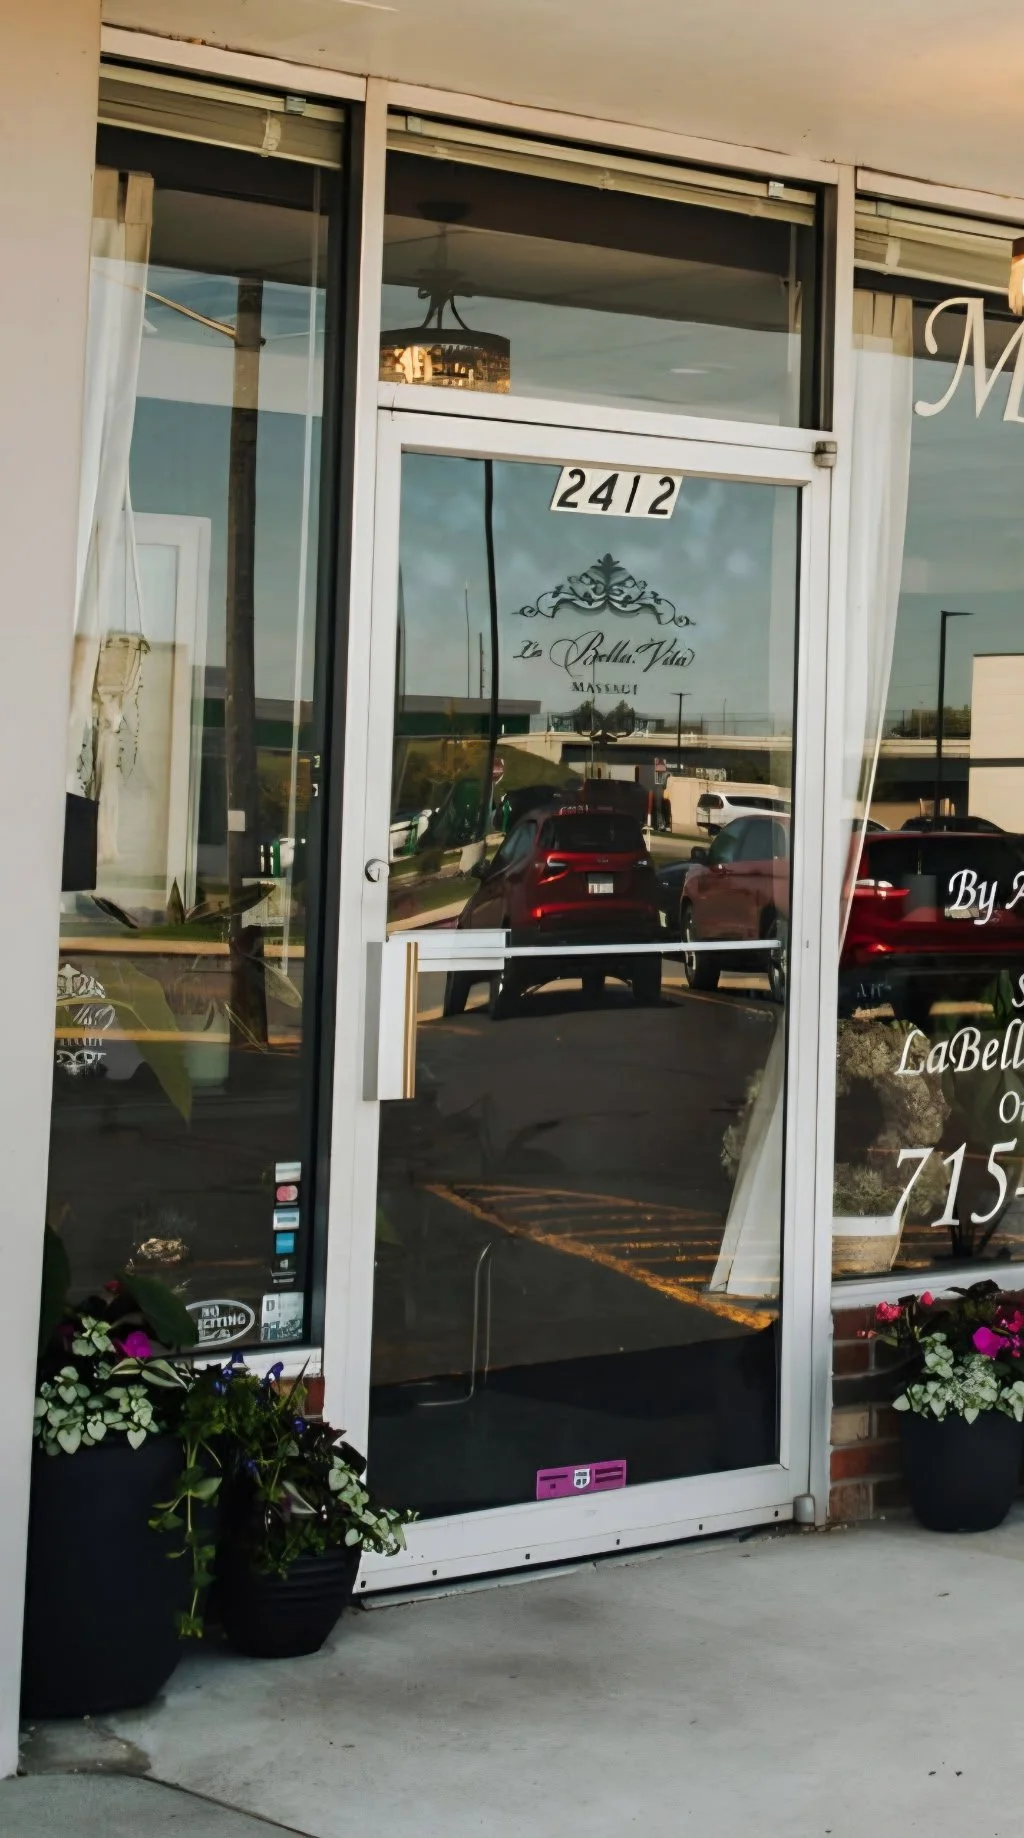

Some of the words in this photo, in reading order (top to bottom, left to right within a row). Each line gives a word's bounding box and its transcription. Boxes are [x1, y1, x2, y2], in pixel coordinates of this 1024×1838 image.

[557, 468, 676, 515] 2412
[550, 631, 636, 678] Bella
[948, 869, 998, 926] By
